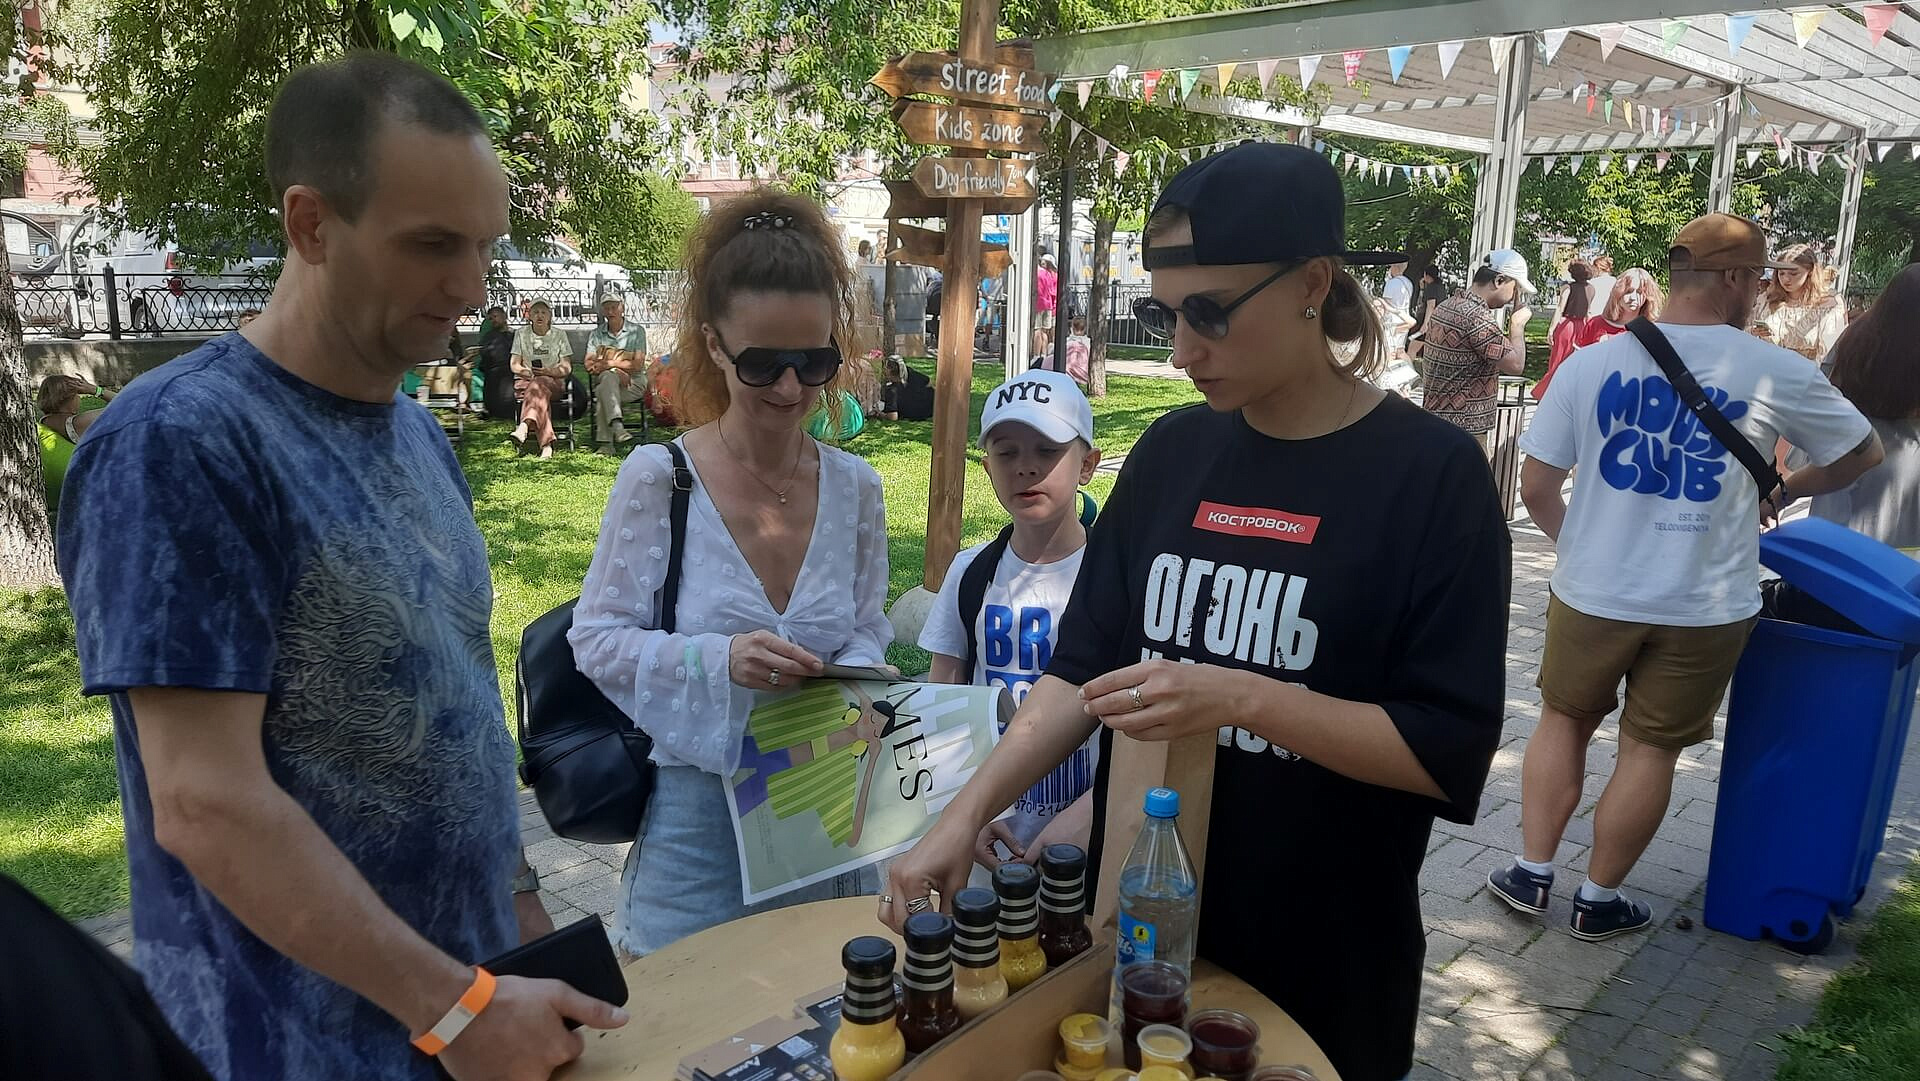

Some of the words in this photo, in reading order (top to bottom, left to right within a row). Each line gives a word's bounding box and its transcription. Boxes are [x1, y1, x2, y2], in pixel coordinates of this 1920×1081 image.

[940, 58, 1012, 96] street
[1013, 71, 1047, 105] food
[935, 108, 973, 142] Kids
[980, 122, 1024, 145] zone
[934, 163, 960, 195] Dog
[964, 161, 1004, 197] friendly
[995, 381, 1052, 410] NYC
[1599, 428, 1727, 503] CLUB
[1143, 552, 1319, 671] ОГОНЬ
